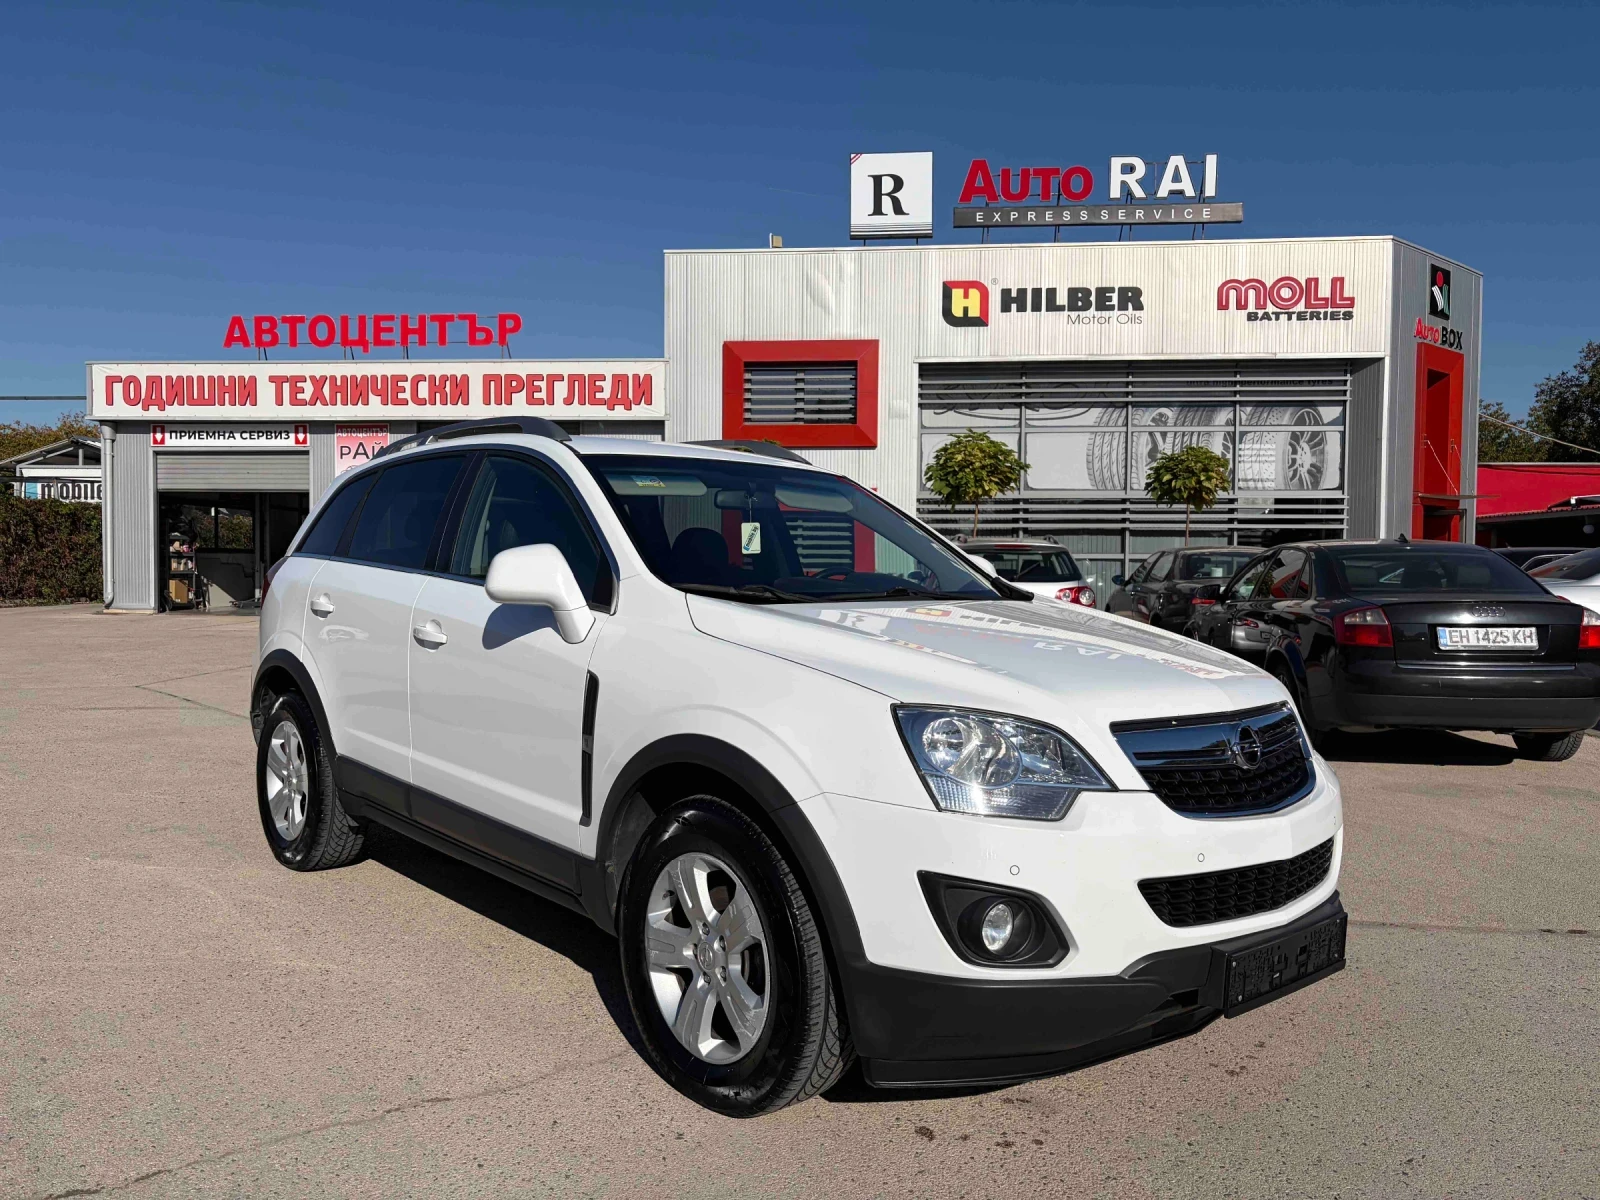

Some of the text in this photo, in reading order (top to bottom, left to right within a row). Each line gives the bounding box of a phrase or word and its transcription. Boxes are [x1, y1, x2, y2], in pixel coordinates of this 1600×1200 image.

[1109, 153, 1219, 200] RAI
[867, 173, 910, 217] R
[976, 207, 1211, 222] EXPRESS SERVICE
[1000, 286, 1144, 313] HILBER
[1067, 313, 1143, 325] Motor Oils
[1246, 310, 1354, 322] BATTERIES
[223, 312, 523, 353] АВТОЦЕНТЪР
[1441, 325, 1463, 350] BOX
[105, 373, 653, 411] ГОДИШНИ ТЕХНИЧЕСКИ ПРЕГЛЕДИ
[169, 430, 290, 441] ПРИЕМНА СЕРВИЗ
[337, 427, 388, 438] АВТОЦЕНТЪР
[1474, 629, 1510, 644] 1425
[1512, 629, 1534, 644] KH
